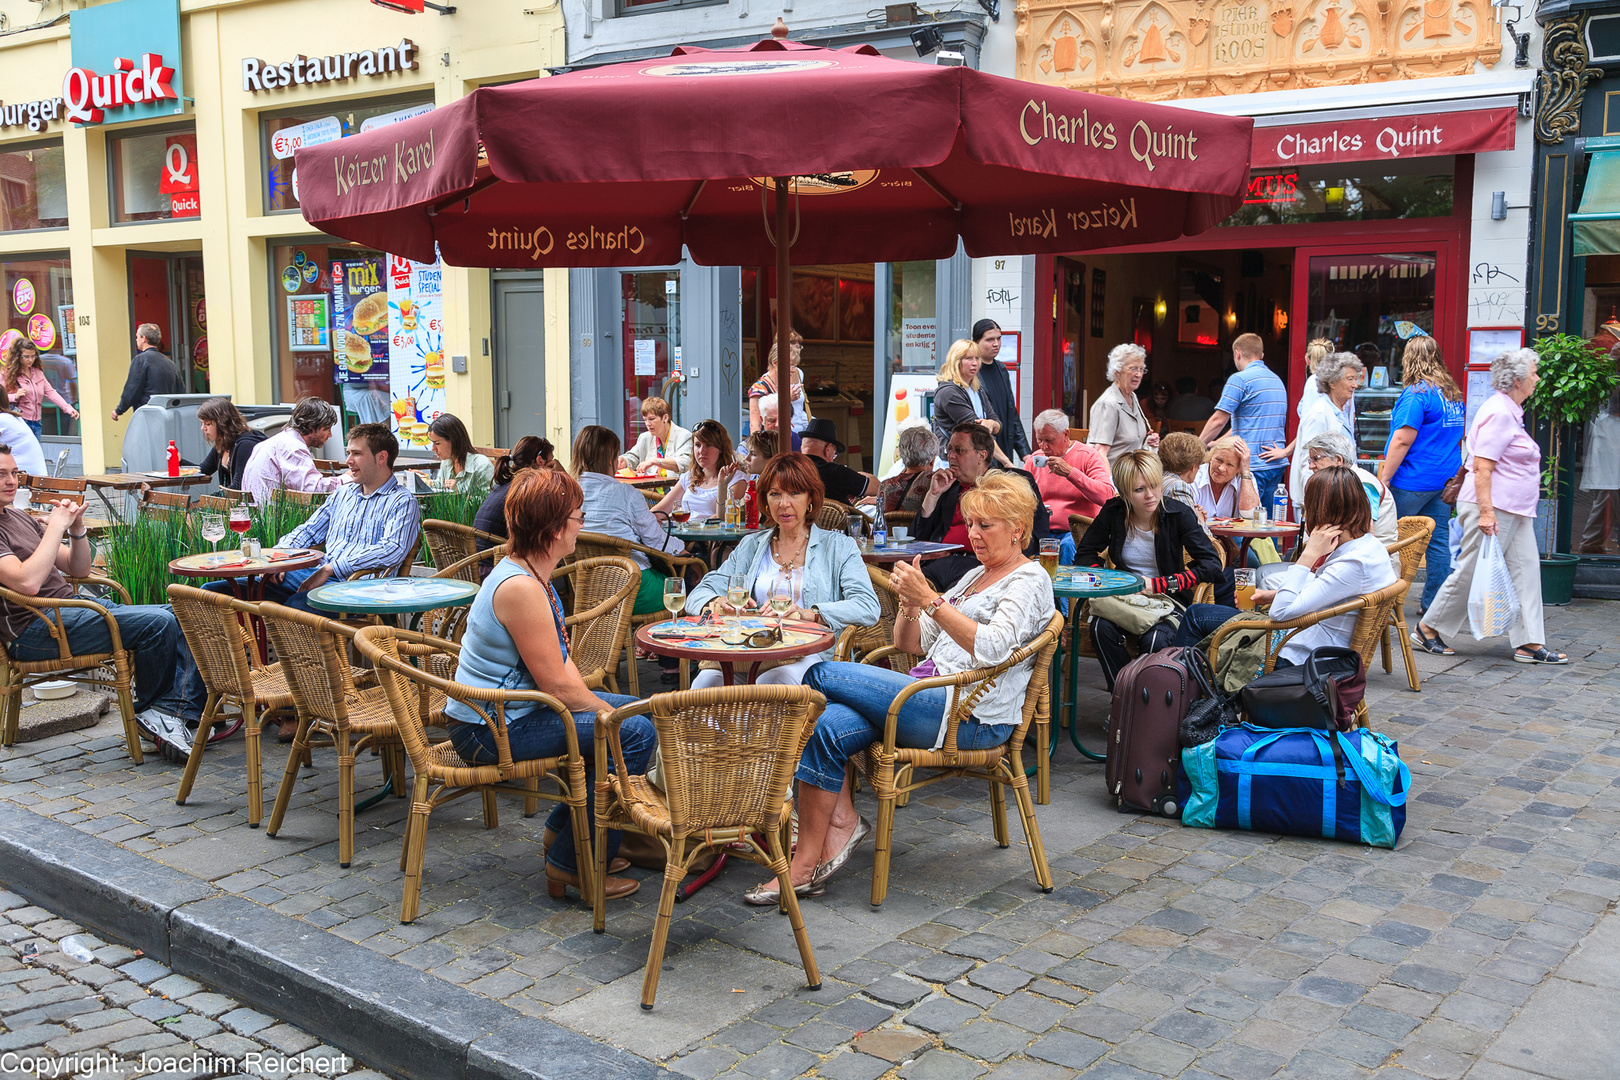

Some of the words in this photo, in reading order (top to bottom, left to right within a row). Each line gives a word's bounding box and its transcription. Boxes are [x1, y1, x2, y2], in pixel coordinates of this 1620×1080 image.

[242, 38, 415, 92] Restaurant
[63, 53, 175, 122] Quick
[1020, 99, 1118, 150] Charles
[1130, 119, 1199, 172] Quint
[1276, 130, 1364, 160] Charles
[1376, 125, 1443, 157] Quint
[275, 136, 302, 155] €3,00
[166, 143, 191, 185] Q
[334, 154, 387, 197] Keizer
[395, 128, 435, 185] Karel
[172, 198, 198, 213] Quick
[994, 260, 1006, 270] 97
[349, 285, 381, 295] burger
[394, 277, 410, 286] Quick
[334, 284, 344, 312] SMAAK
[79, 316, 90, 326] 103
[1536, 314, 1559, 331] 95
[337, 329, 346, 350] VOOR
[393, 335, 415, 349] €3,00
[915, 341, 930, 349] krijg
[338, 352, 348, 371] GAAT
